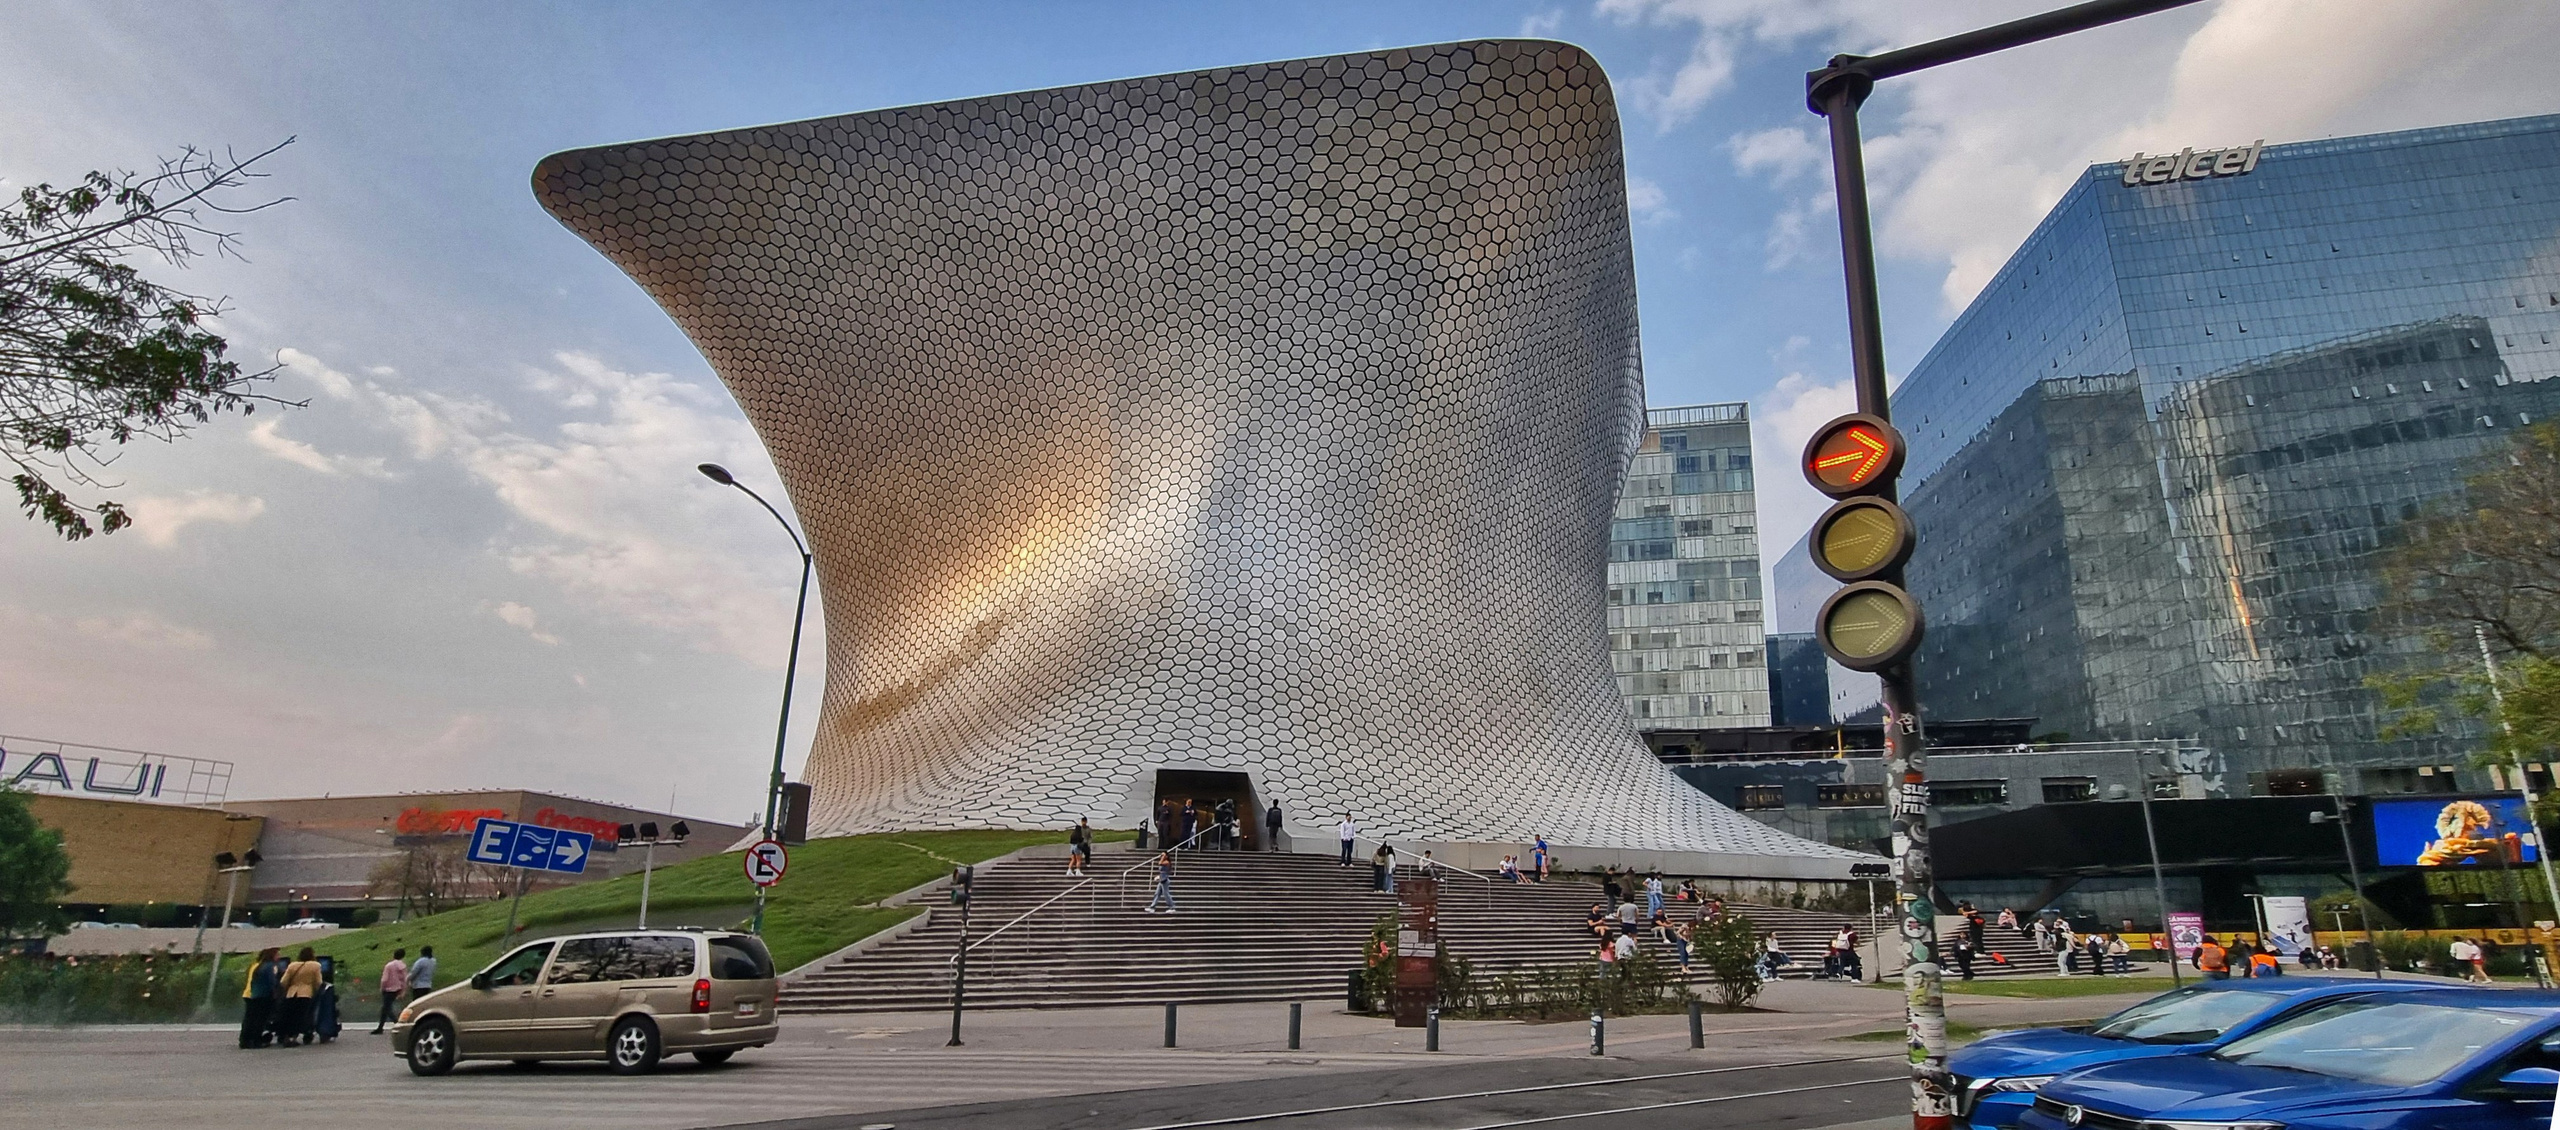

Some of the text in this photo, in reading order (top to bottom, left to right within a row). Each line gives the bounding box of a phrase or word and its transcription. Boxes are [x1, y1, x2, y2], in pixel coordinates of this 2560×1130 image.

[2123, 139, 2265, 185] telcel
[0, 746, 166, 797] AUI
[476, 823, 510, 860] E
[756, 850, 776, 876] E
